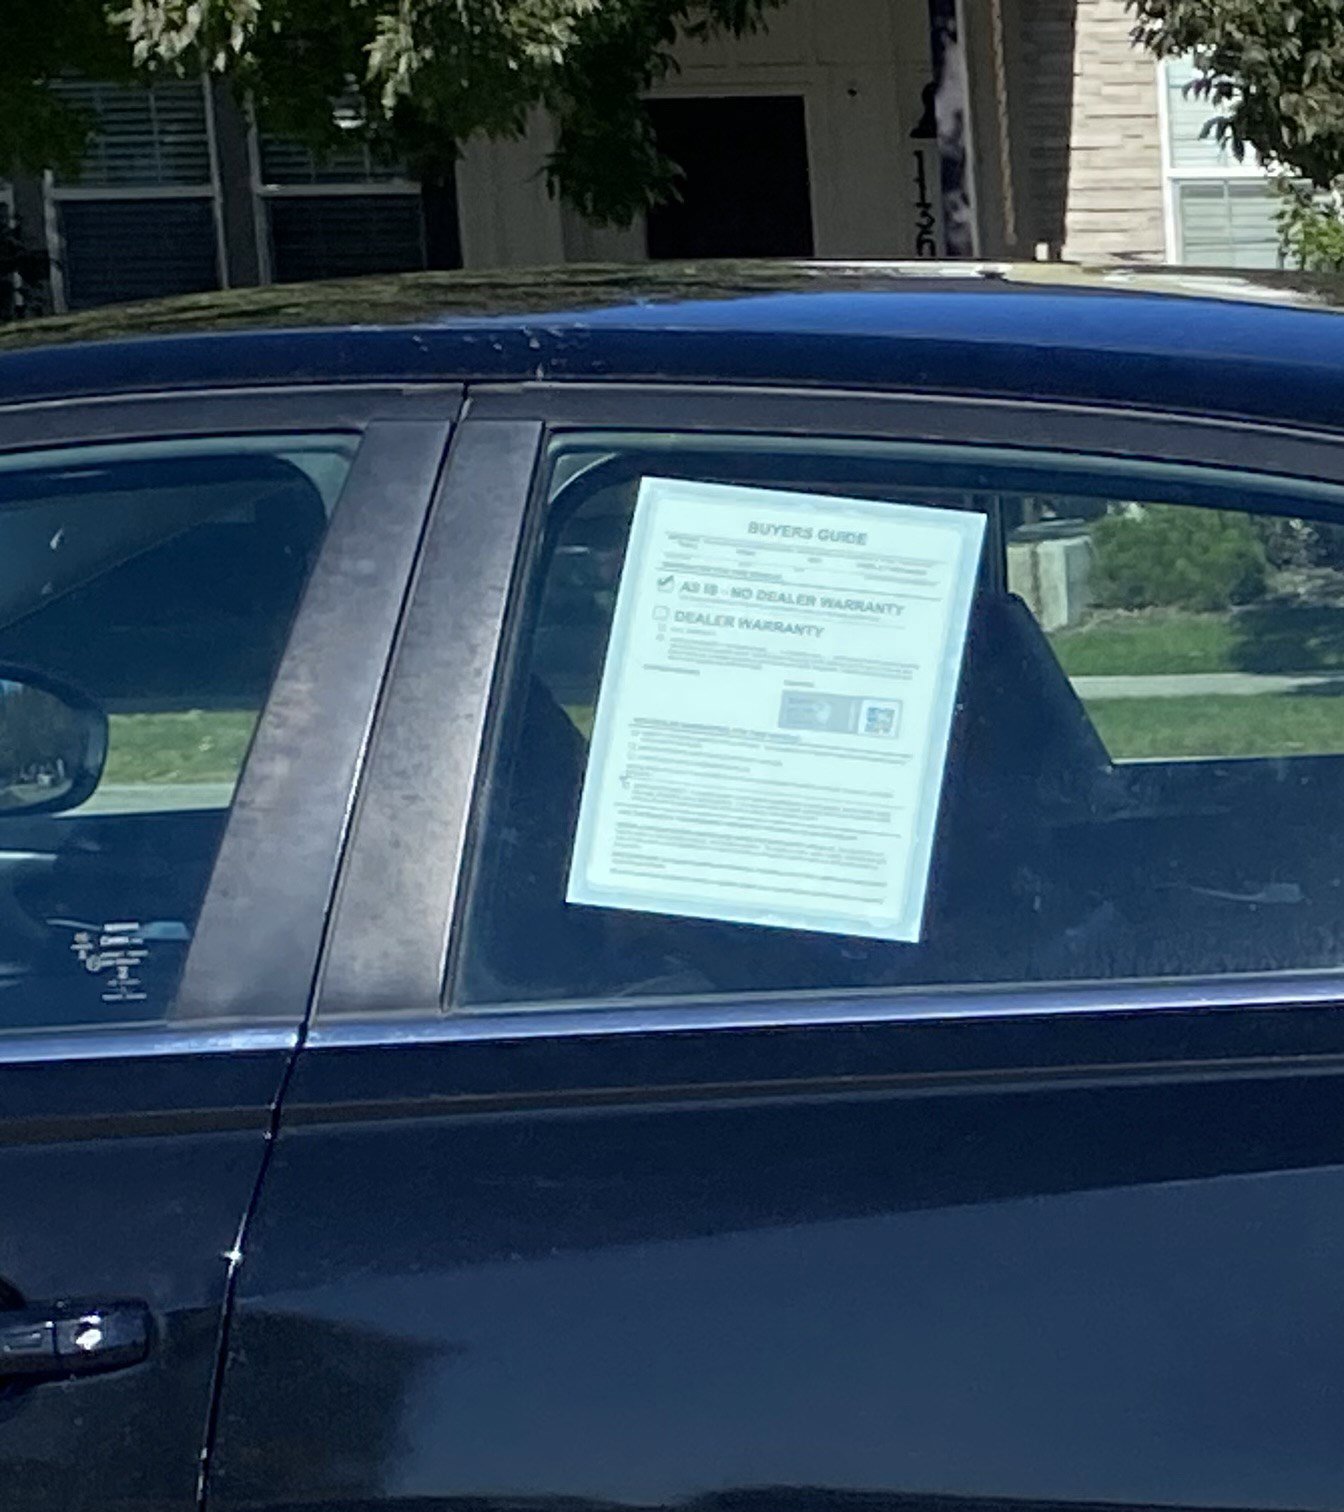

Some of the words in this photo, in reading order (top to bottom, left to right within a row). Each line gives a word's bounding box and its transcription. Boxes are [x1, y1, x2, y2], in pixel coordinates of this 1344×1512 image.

[747, 520, 813, 540] BUYERS
[817, 528, 869, 546] GUIDE
[680, 581, 700, 593] AS
[730, 587, 753, 600] NO
[755, 589, 817, 607] DEALER
[820, 597, 905, 616] WARRANTY
[674, 610, 735, 628] DEALER
[738, 617, 826, 638] WARRANTY
